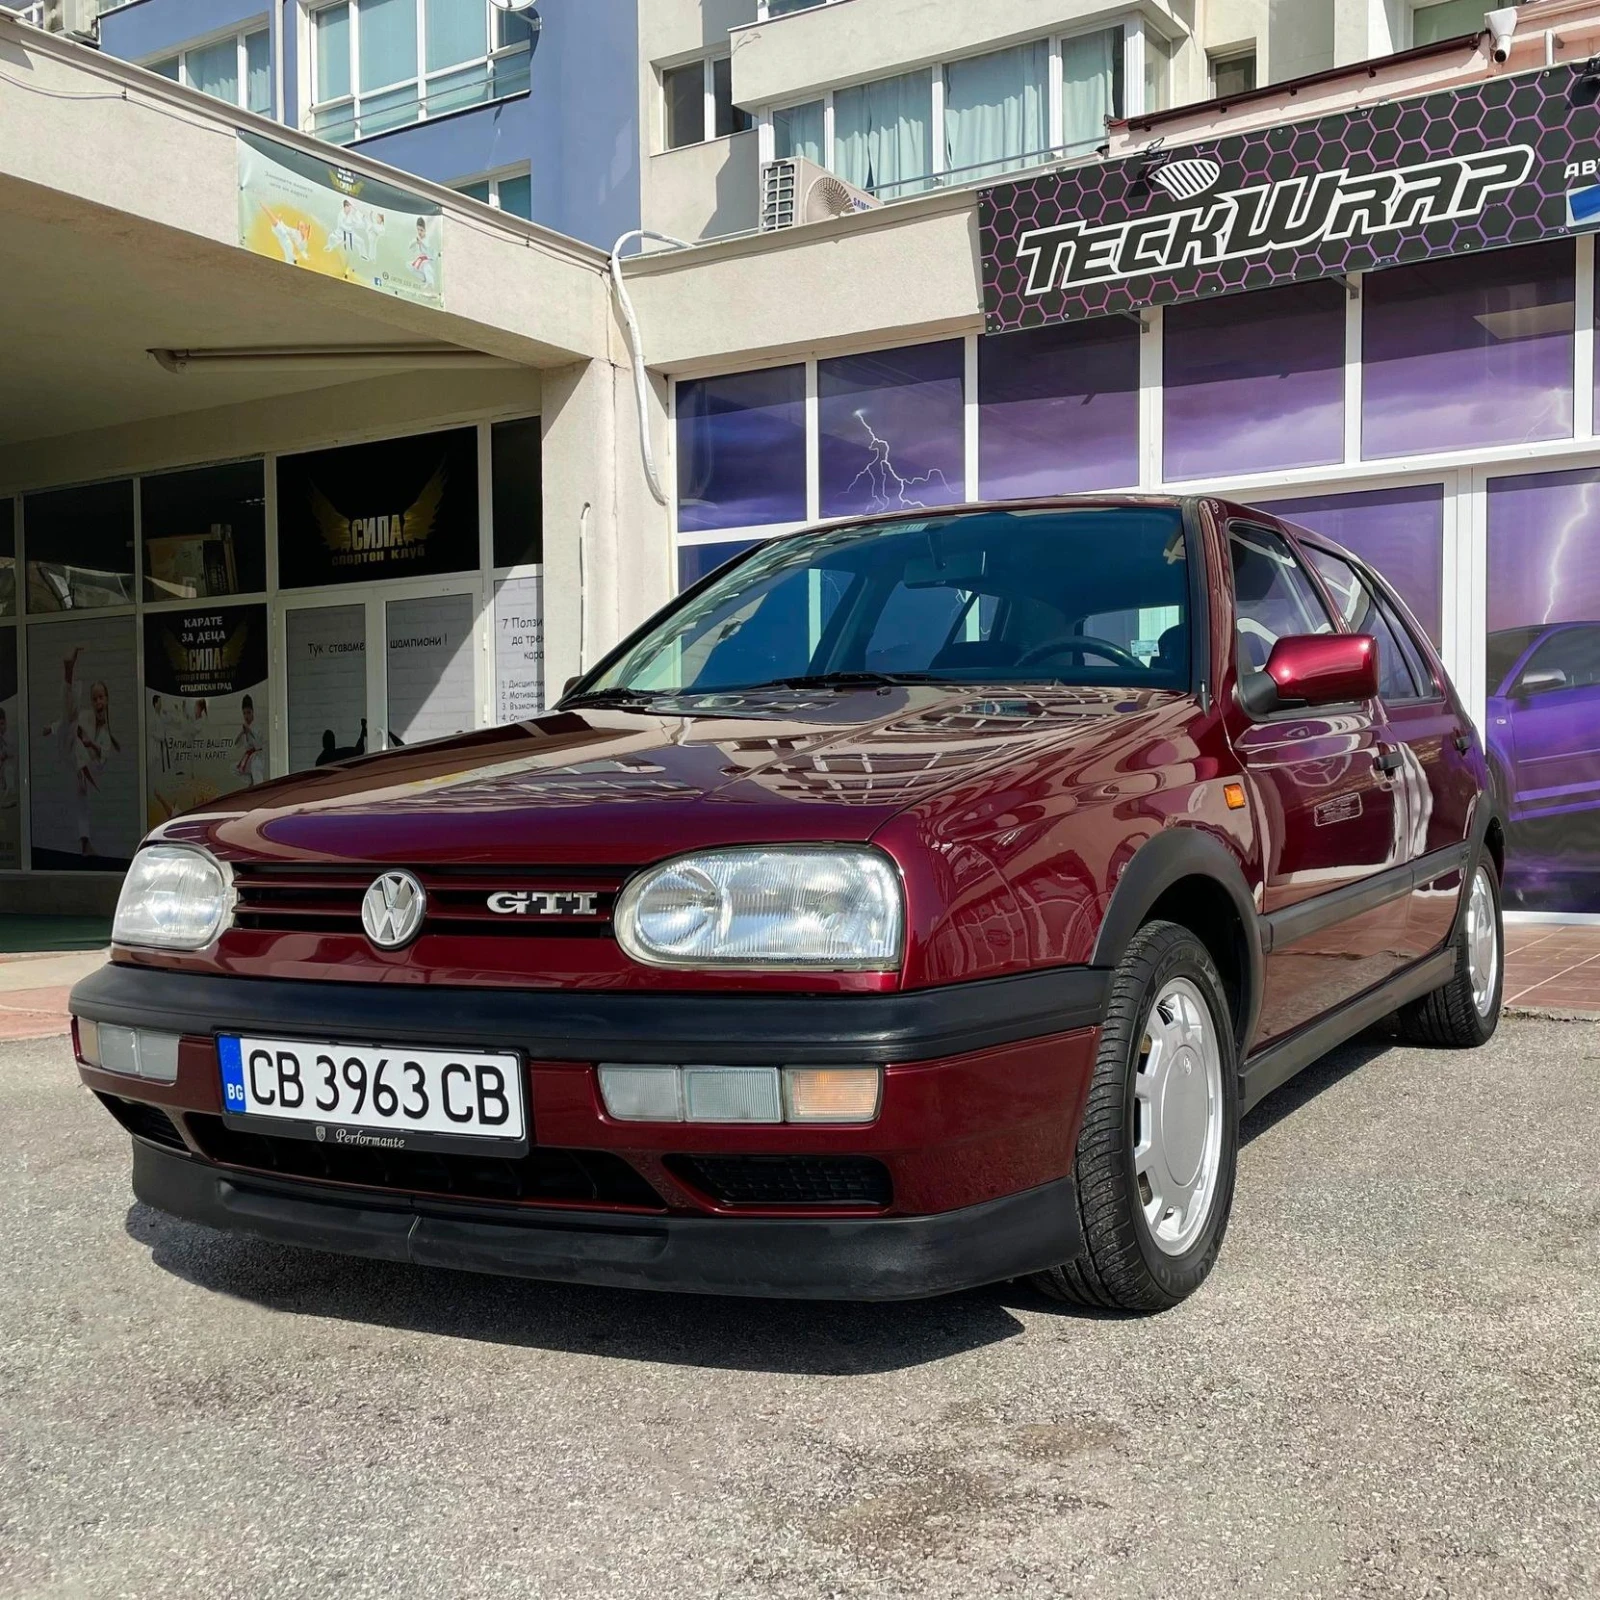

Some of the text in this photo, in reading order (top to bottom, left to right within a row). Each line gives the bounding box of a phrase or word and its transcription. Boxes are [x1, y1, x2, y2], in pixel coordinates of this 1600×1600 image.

[1563, 158, 1600, 179] АВ
[1016, 143, 1535, 297] TECKWRAP
[351, 514, 403, 551] СИЛА
[184, 616, 223, 628] КАРАТЕ
[502, 618, 508, 629] 7
[181, 630, 226, 644] ЗА ДЕЦА
[511, 636, 523, 646] да
[188, 647, 222, 671] СИЛА
[308, 642, 364, 657] Тук ставаме
[523, 651, 544, 662] кара
[486, 892, 598, 915] GTI
[227, 1083, 244, 1101] BG
[315, 1055, 430, 1119] 3963
[335, 1128, 405, 1149] Performante
